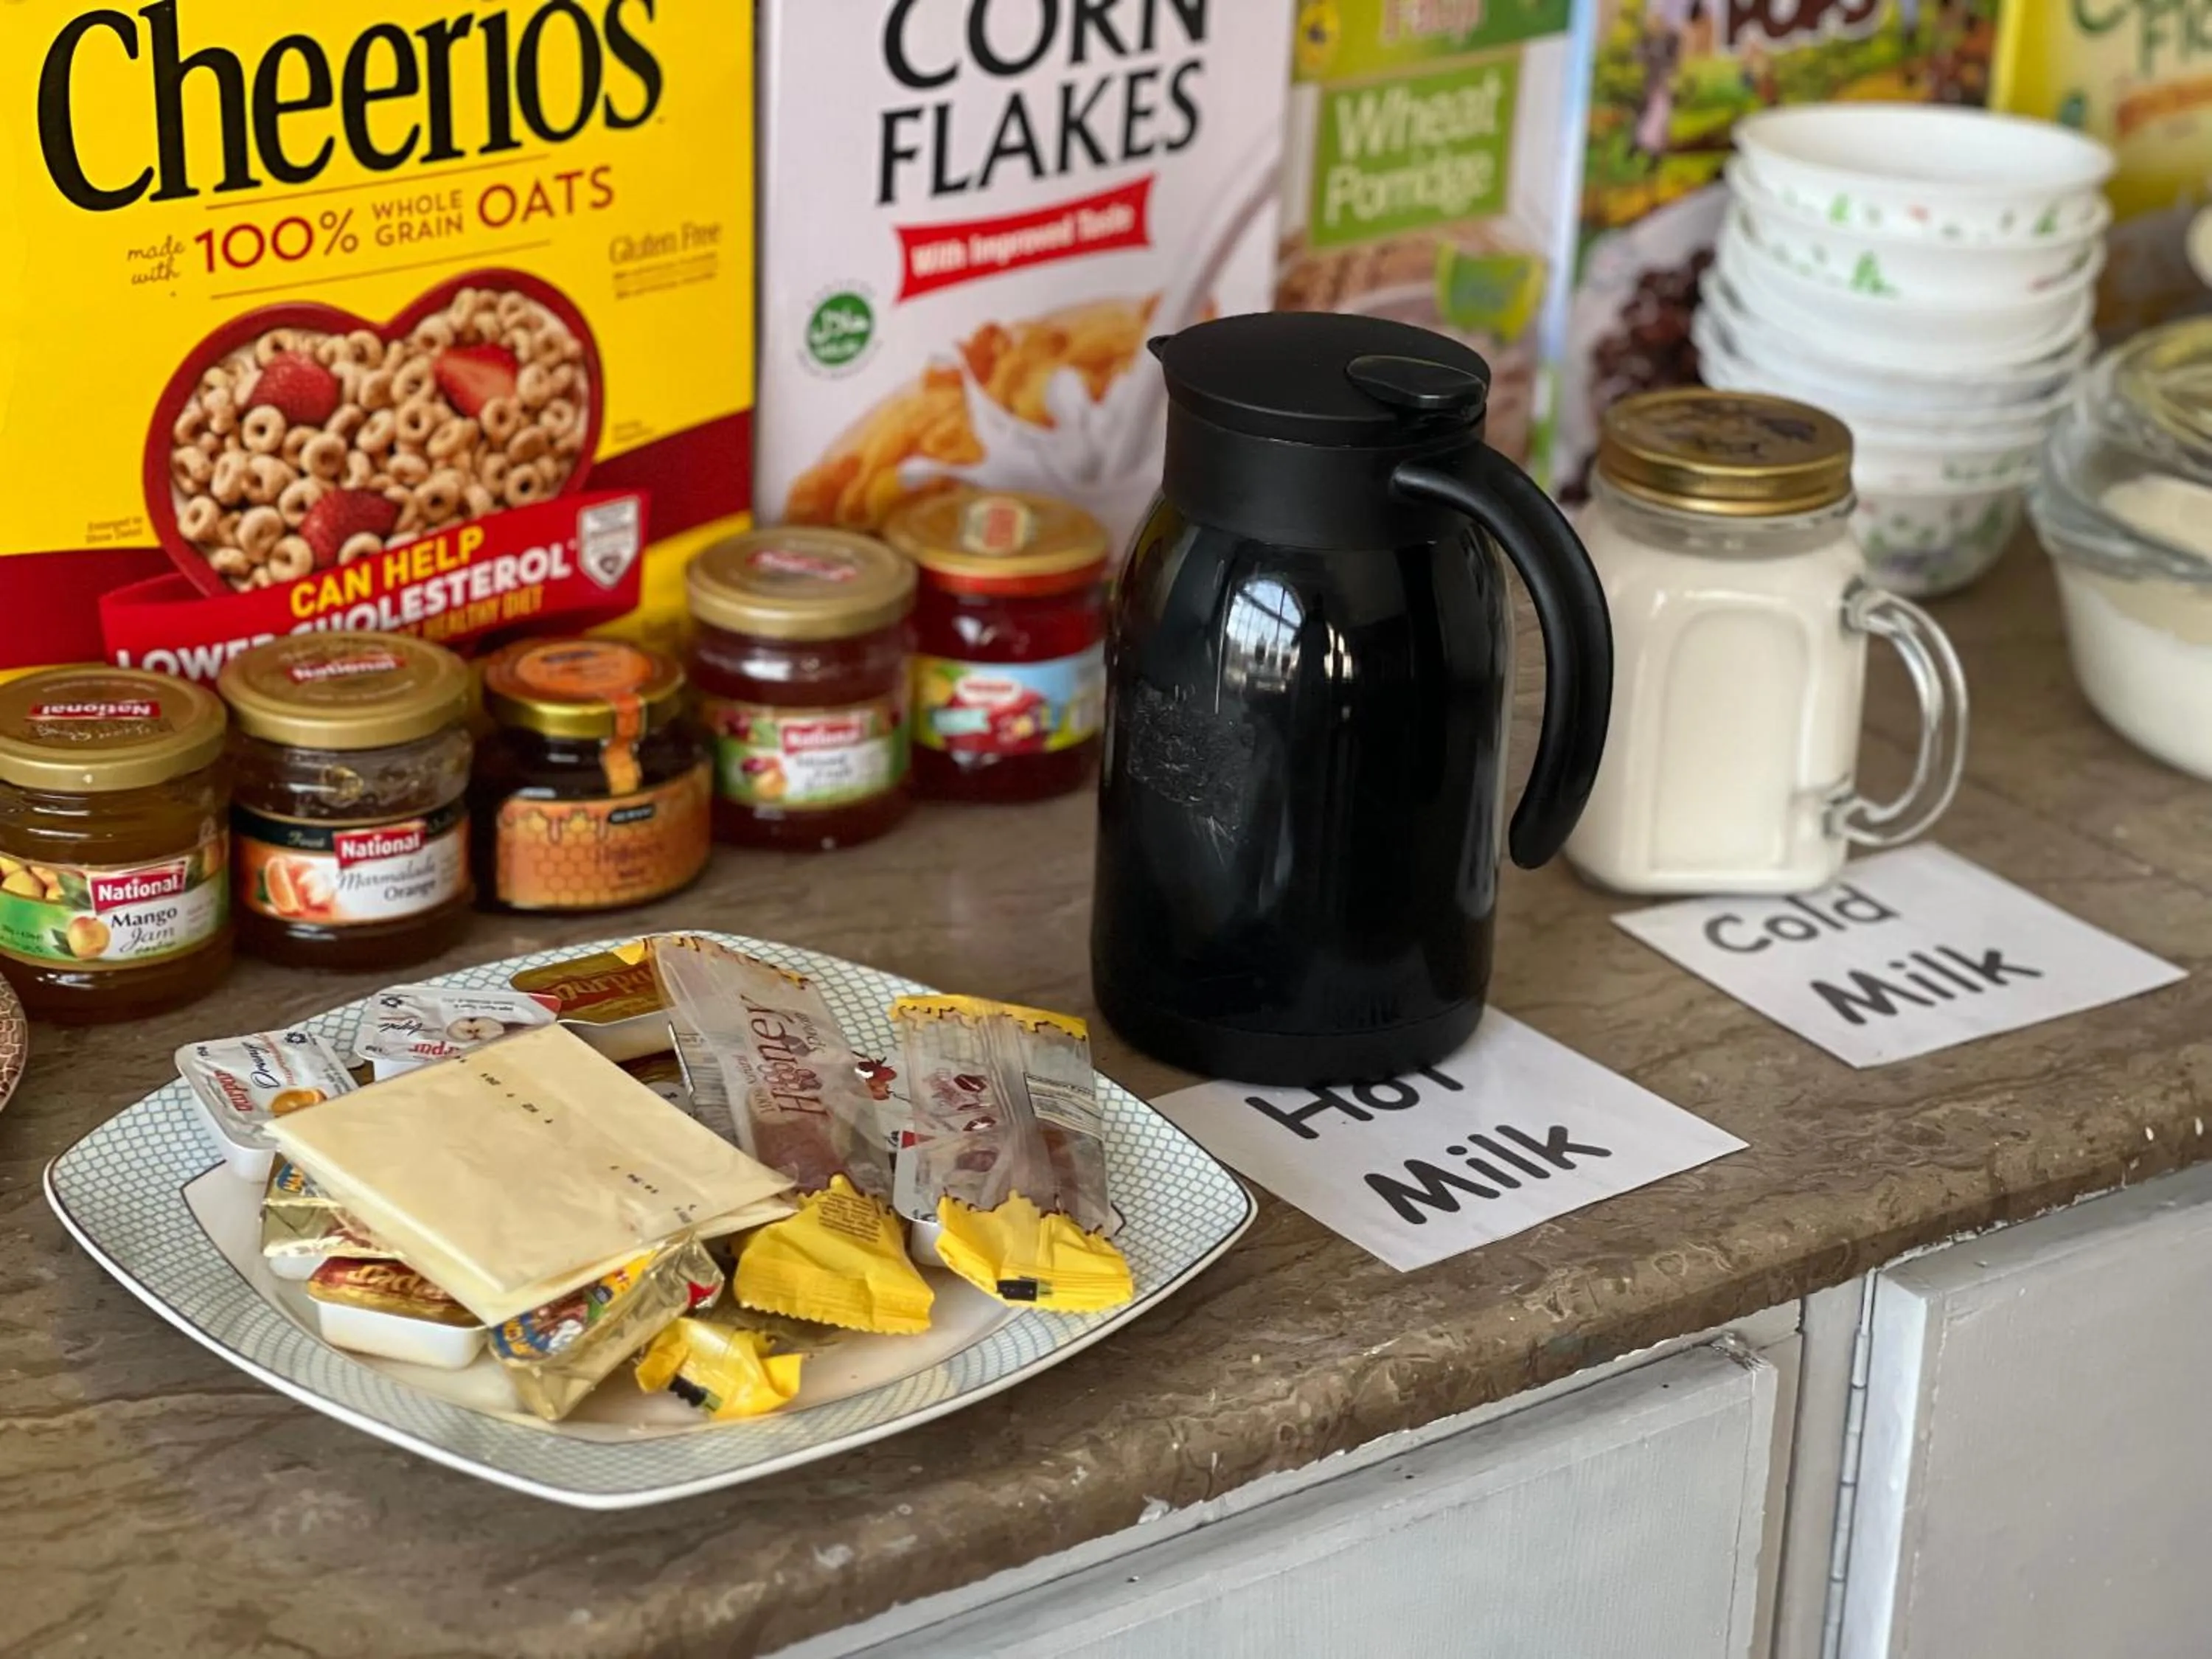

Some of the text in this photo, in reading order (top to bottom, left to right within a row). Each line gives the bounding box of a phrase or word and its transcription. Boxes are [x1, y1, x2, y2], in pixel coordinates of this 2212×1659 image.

[38, 0, 663, 211] Cheerios
[1335, 70, 1500, 161] Wheat
[876, 59, 1203, 204] FLAKES
[372, 189, 463, 220] WHOLE
[476, 165, 615, 229] OATS
[127, 234, 185, 261] made
[193, 207, 359, 274] 100%
[375, 214, 464, 248] GRAIN
[131, 262, 180, 285] with
[291, 525, 486, 618] CAN HELP
[116, 634, 274, 681] LOW
[341, 833, 420, 858] National
[97, 875, 178, 902] National
[336, 857, 437, 891] Marmalade
[111, 907, 178, 928] Mango
[1704, 884, 1900, 953] Cold
[119, 926, 175, 953] Jam
[1809, 945, 2044, 1026] Milk
[408, 1040, 460, 1057] rpur
[1363, 1124, 1613, 1225] Milk
